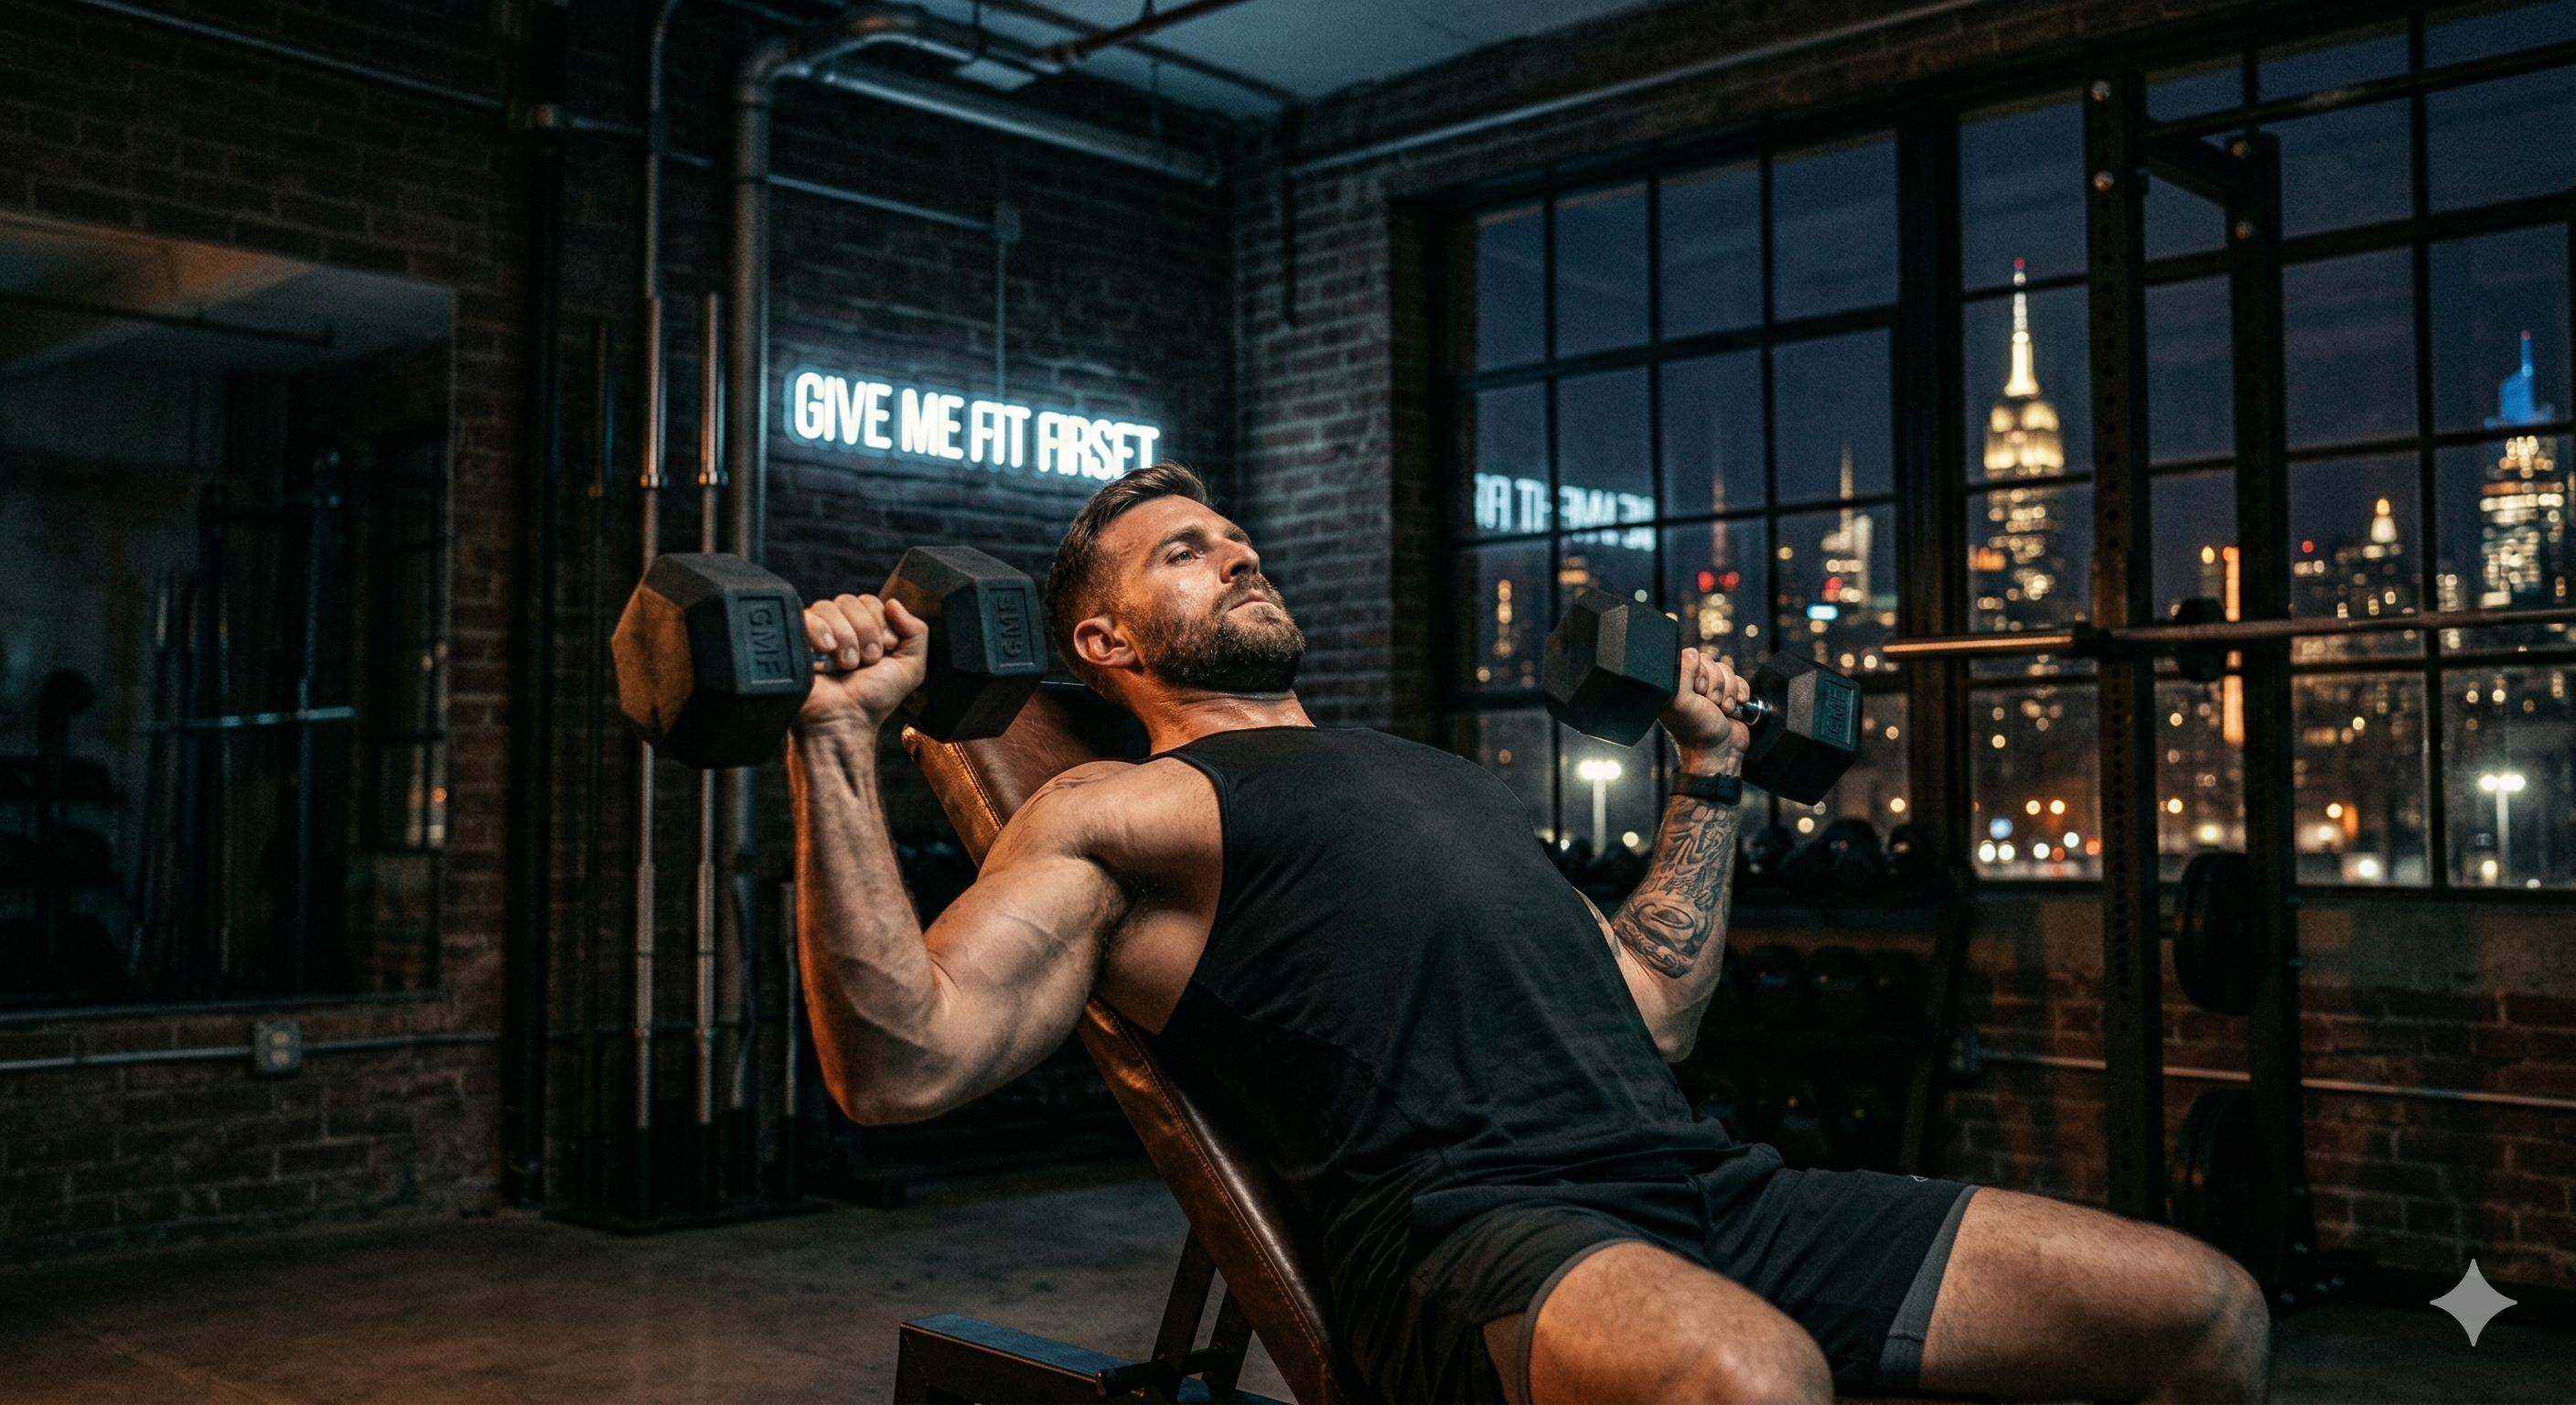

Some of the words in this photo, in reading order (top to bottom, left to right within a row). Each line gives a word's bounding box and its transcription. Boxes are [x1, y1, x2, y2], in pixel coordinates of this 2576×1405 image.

[794, 371, 893, 449] GIVE
[901, 388, 964, 460] ME
[971, 400, 1032, 468] FIT
[749, 607, 780, 674] GMF
[996, 595, 1024, 658] GMF
[1826, 687, 1847, 736] GMF
